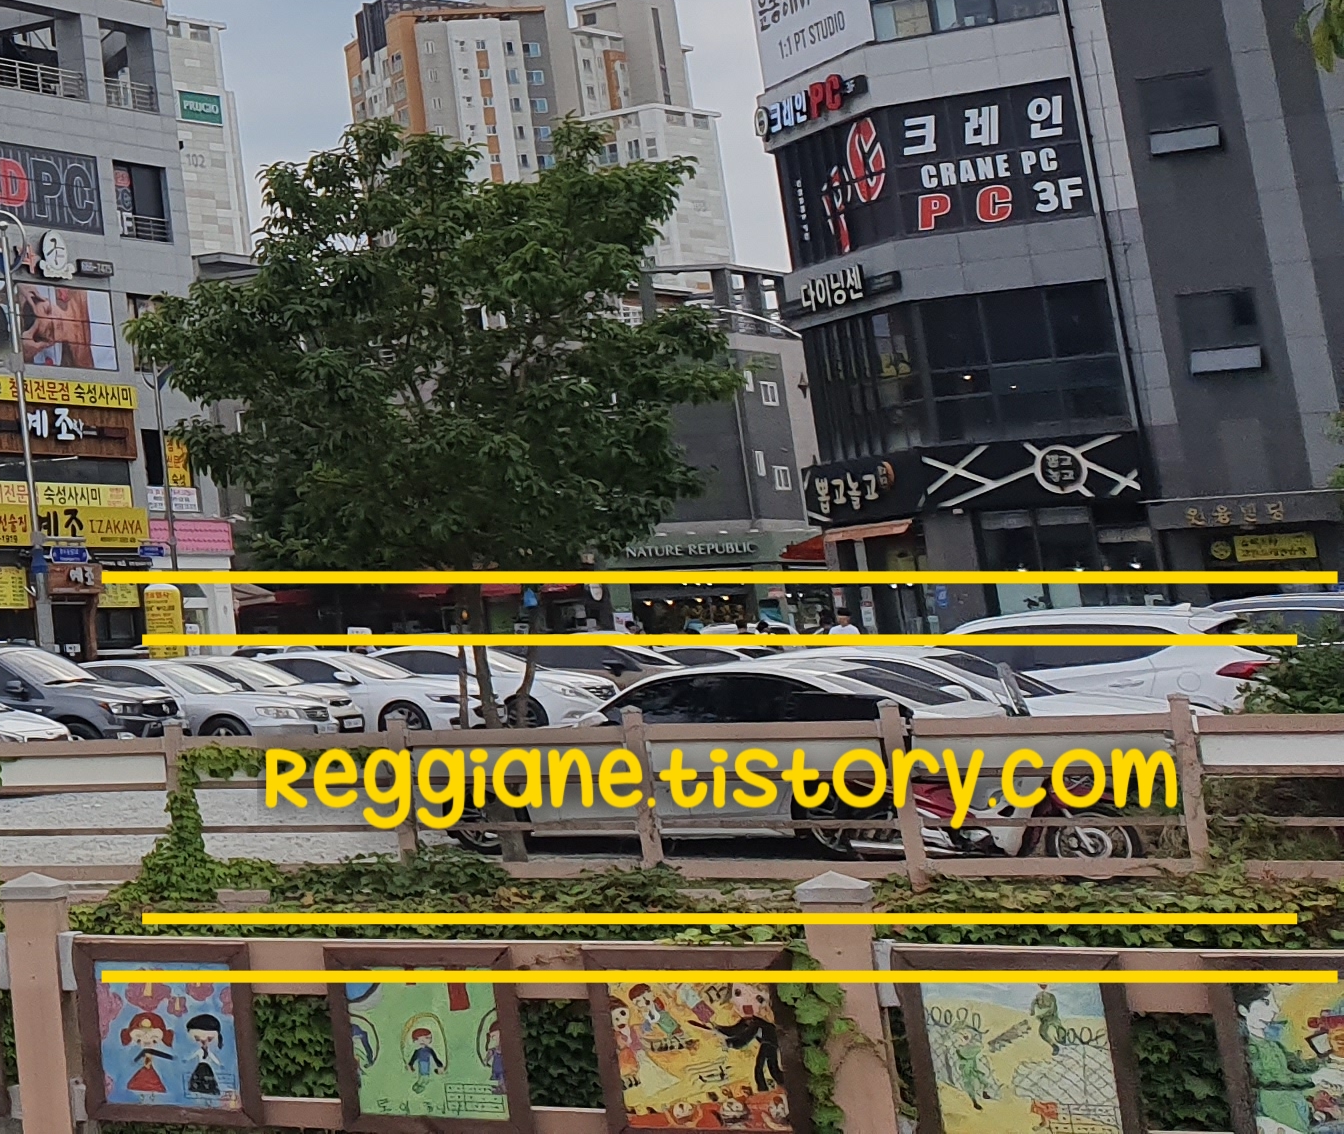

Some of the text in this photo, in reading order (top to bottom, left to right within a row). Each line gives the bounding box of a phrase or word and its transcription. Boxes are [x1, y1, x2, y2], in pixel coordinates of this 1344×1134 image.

[778, 10, 845, 59] 1:1 PT STUDIO
[903, 95, 1063, 156] 크레인
[186, 153, 205, 168] 102
[921, 147, 1058, 189] CRANE PC
[30, 158, 97, 224] PC
[918, 177, 1083, 231] PC 3F
[74, 383, 132, 406] 숙성사시미
[44, 486, 102, 506] 숙성사시미
[89, 519, 143, 535] IZAKAYA
[626, 541, 758, 559] NATURE REPUBLIC
